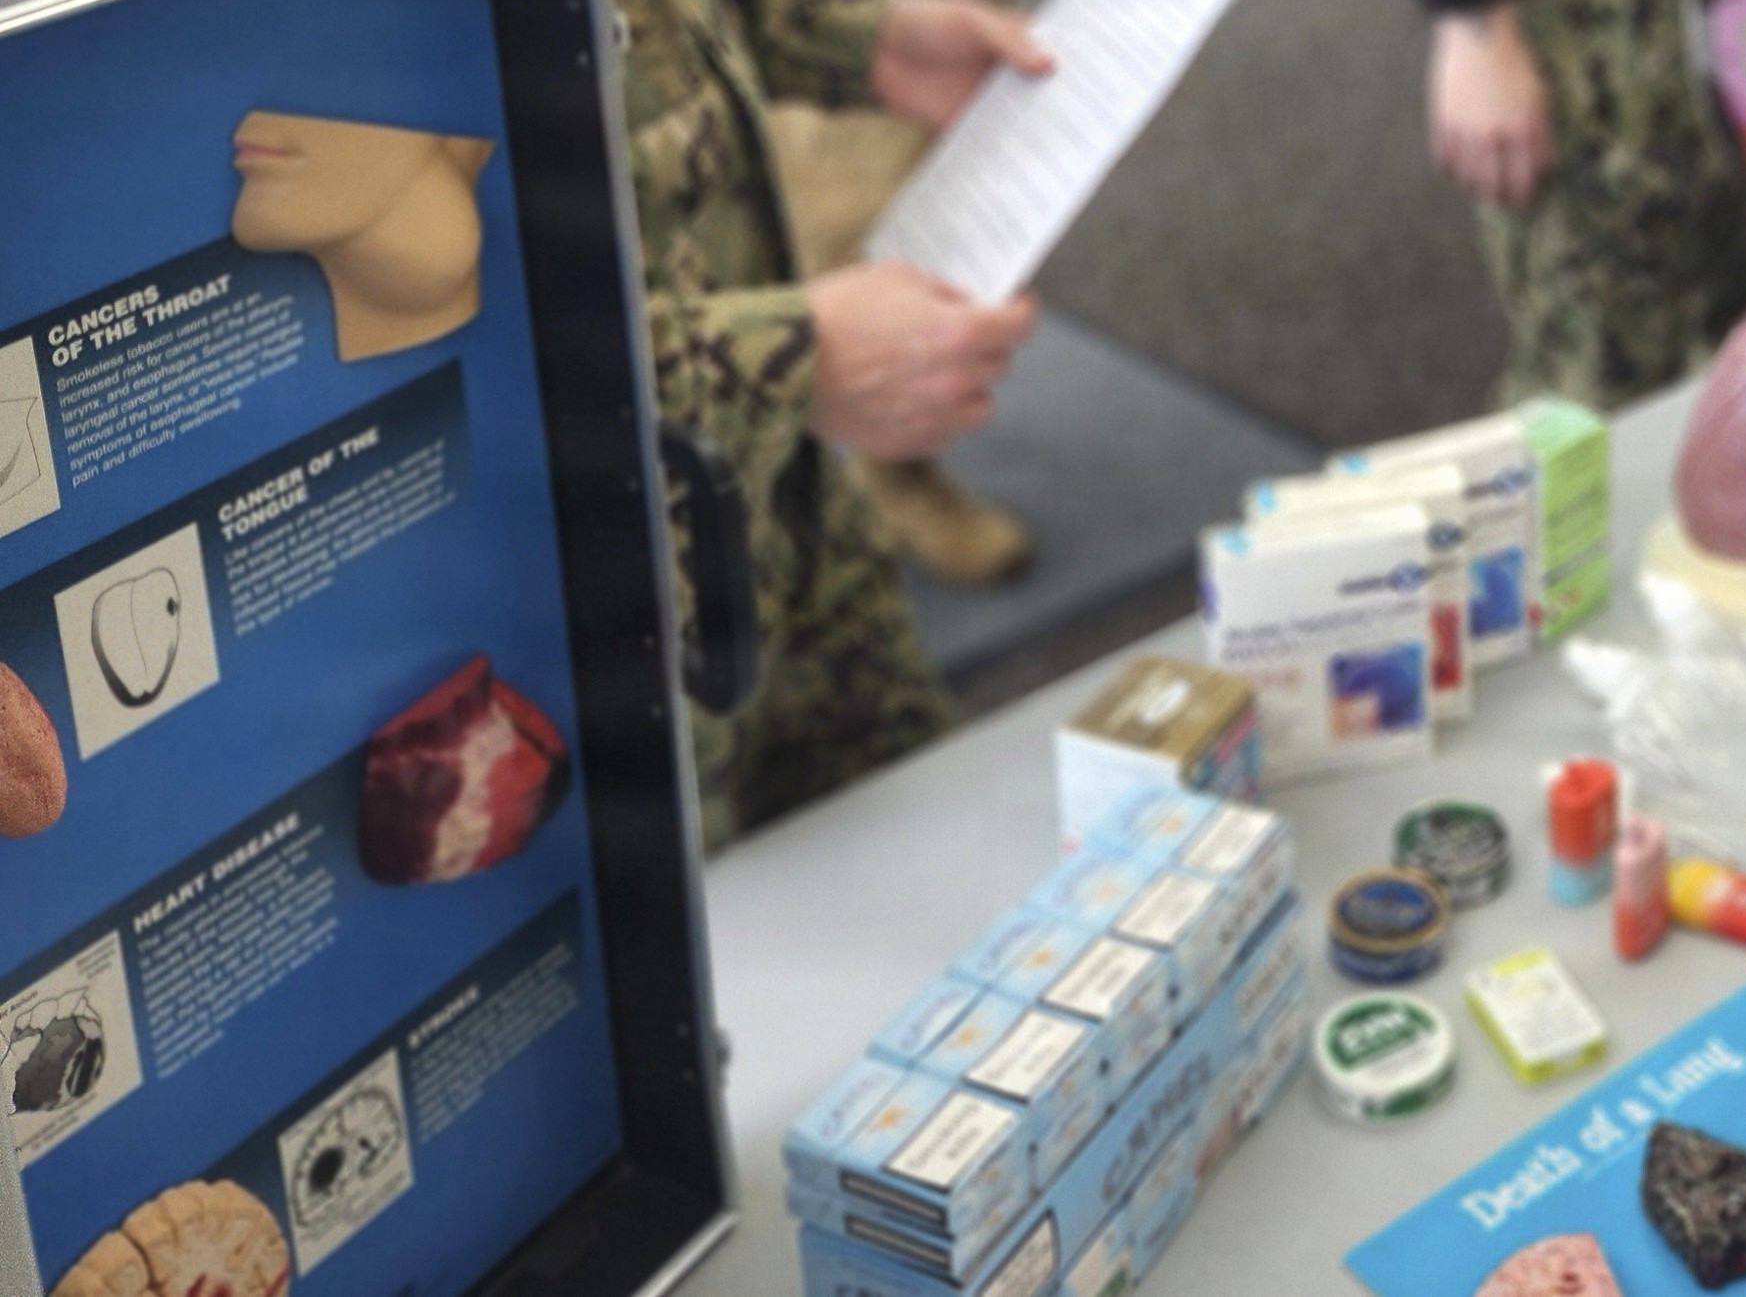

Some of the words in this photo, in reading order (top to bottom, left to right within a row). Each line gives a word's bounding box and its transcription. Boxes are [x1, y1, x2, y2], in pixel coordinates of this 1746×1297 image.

[48, 284, 159, 347] CANCERS
[52, 339, 83, 368] OF
[89, 316, 138, 351] THE
[142, 273, 231, 327] THROAT
[56, 354, 125, 392] Smokeless
[126, 331, 174, 361] tobacco
[176, 315, 209, 339] users
[60, 371, 120, 409] increased
[122, 362, 144, 381] risk
[146, 352, 162, 368] for
[164, 331, 211, 359] cancers
[62, 398, 104, 424] larynx,
[107, 382, 130, 403] and
[64, 404, 119, 442] laryngeal
[120, 387, 159, 414] cancer
[160, 358, 221, 394] sometimes
[67, 424, 114, 456] removal
[116, 416, 128, 432] of
[129, 408, 148, 426] the
[187, 384, 199, 398] or
[69, 432, 133, 472] symptoms
[135, 423, 148, 440] of
[150, 390, 217, 432] esophageal
[72, 464, 99, 490] pain
[102, 450, 126, 473] and
[128, 426, 176, 459] difficulty
[218, 466, 305, 523] CANCER
[308, 449, 335, 477] OF
[339, 426, 381, 461] THE
[221, 485, 309, 542] TONGUE
[133, 873, 207, 934] HEART
[212, 811, 300, 882] DISEASE
[1459, 1145, 1582, 1231] Death
[1577, 1105, 1626, 1154] of
[1618, 1098, 1654, 1126] a
